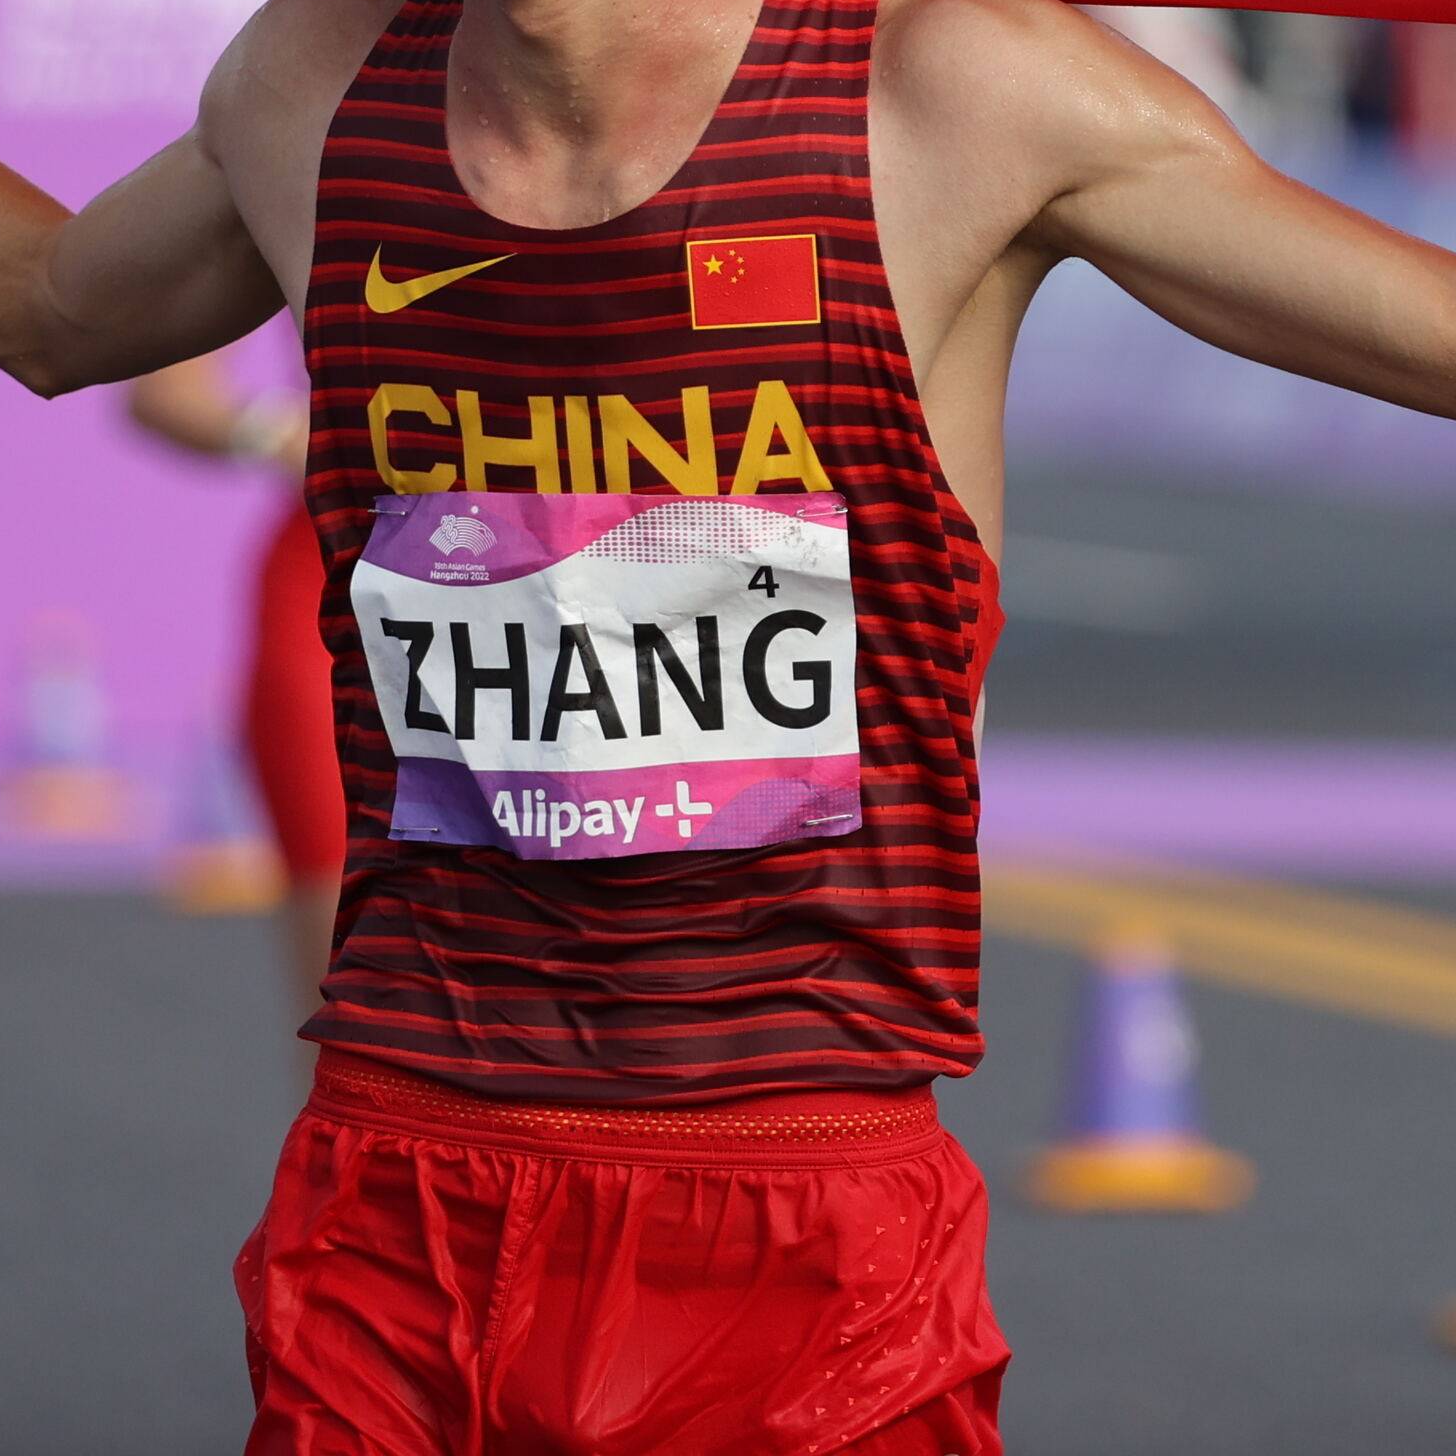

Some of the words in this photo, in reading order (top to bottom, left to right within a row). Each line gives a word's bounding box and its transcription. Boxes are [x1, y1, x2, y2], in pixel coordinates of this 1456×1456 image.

[367, 380, 833, 495] CHINA
[430, 570, 469, 581] Hangzhou
[471, 571, 490, 581] 2022
[448, 562, 465, 570] Asian
[465, 563, 486, 571] Games
[748, 565, 780, 598] 4
[380, 609, 832, 742] ZHANG
